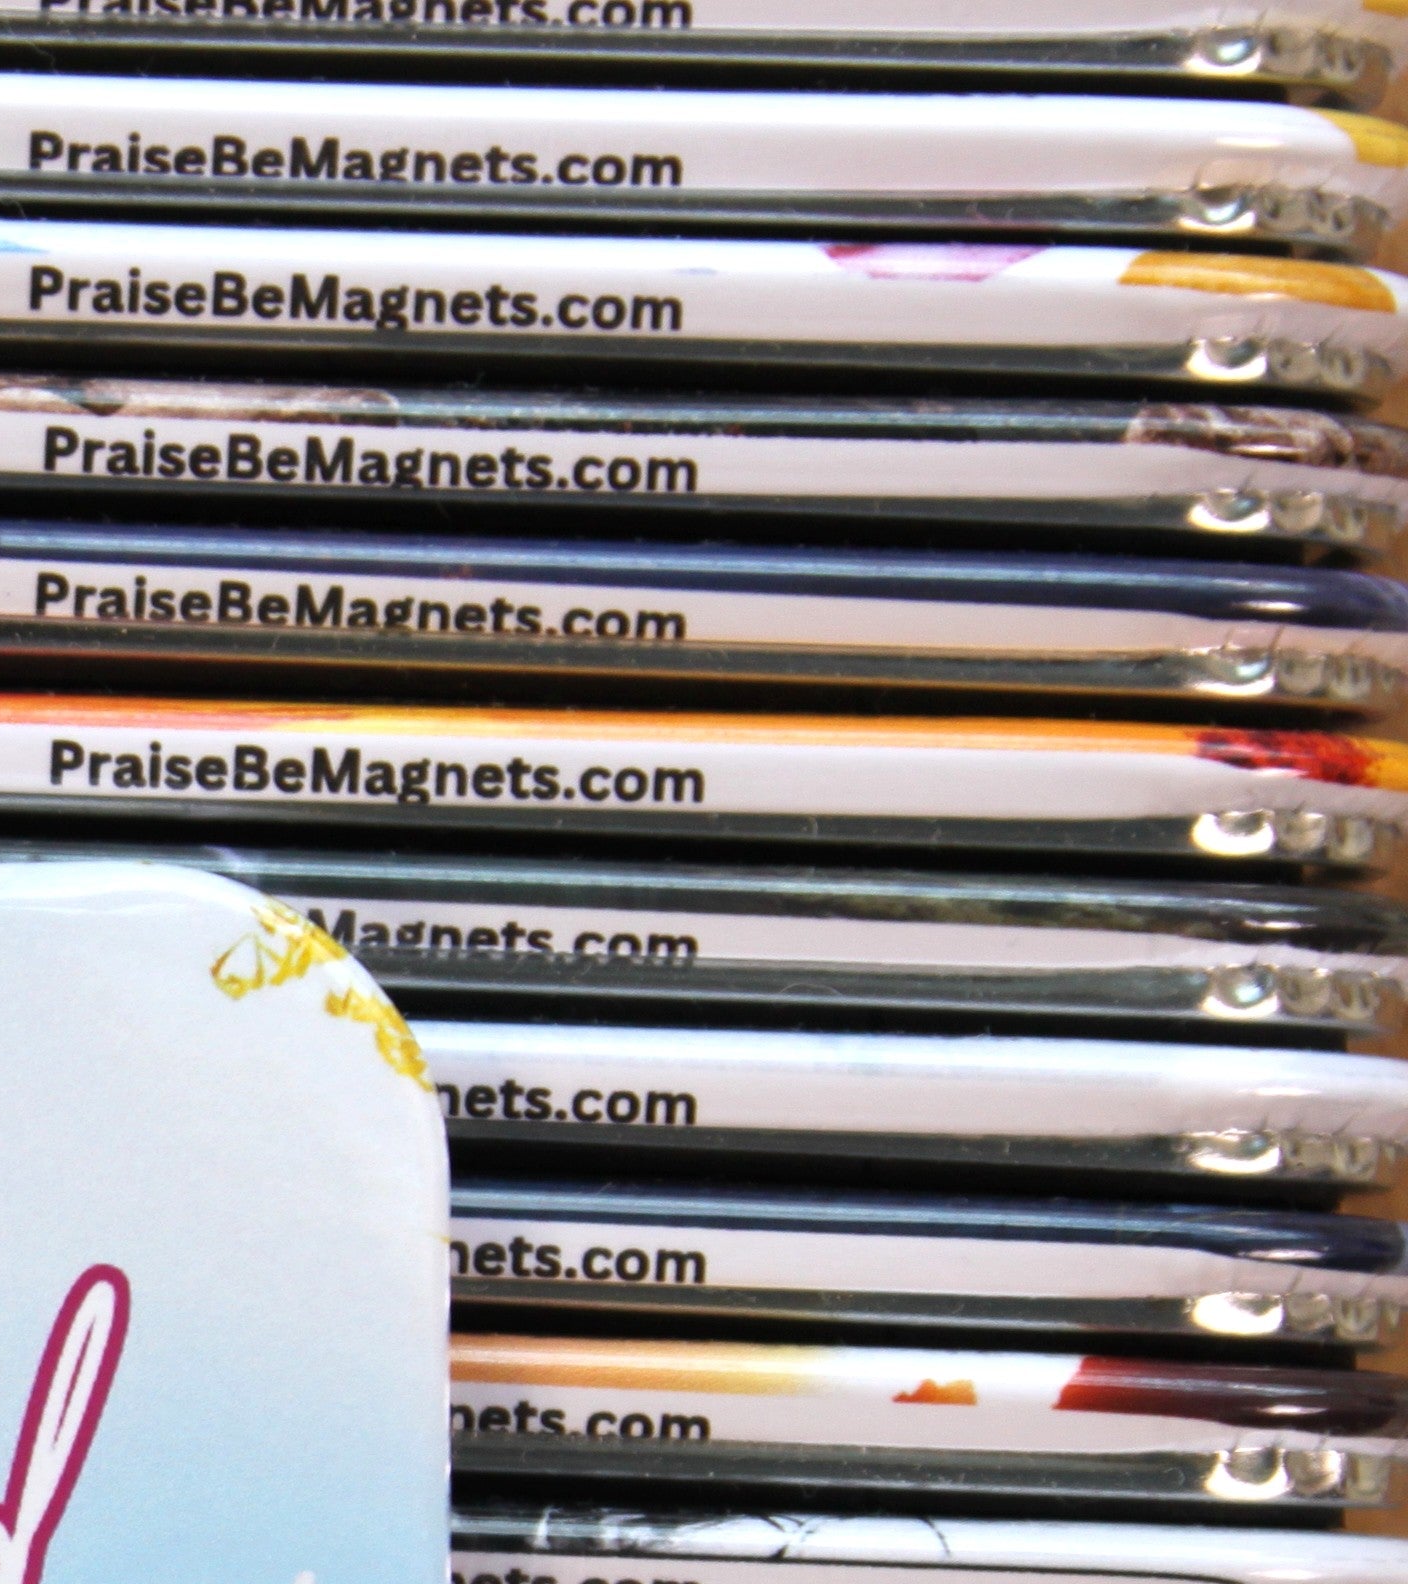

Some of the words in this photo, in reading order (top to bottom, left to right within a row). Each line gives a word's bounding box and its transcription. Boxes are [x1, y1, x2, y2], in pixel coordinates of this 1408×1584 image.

[29, 131, 682, 186] PraiseBeMagnets.com
[29, 266, 682, 331] PraiseBeMagnets.com
[43, 426, 698, 491] PraiseBeMagnets.com
[35, 572, 687, 639] PraiseBeMagnets.com
[50, 739, 704, 803] PraiseBeMagnets.com
